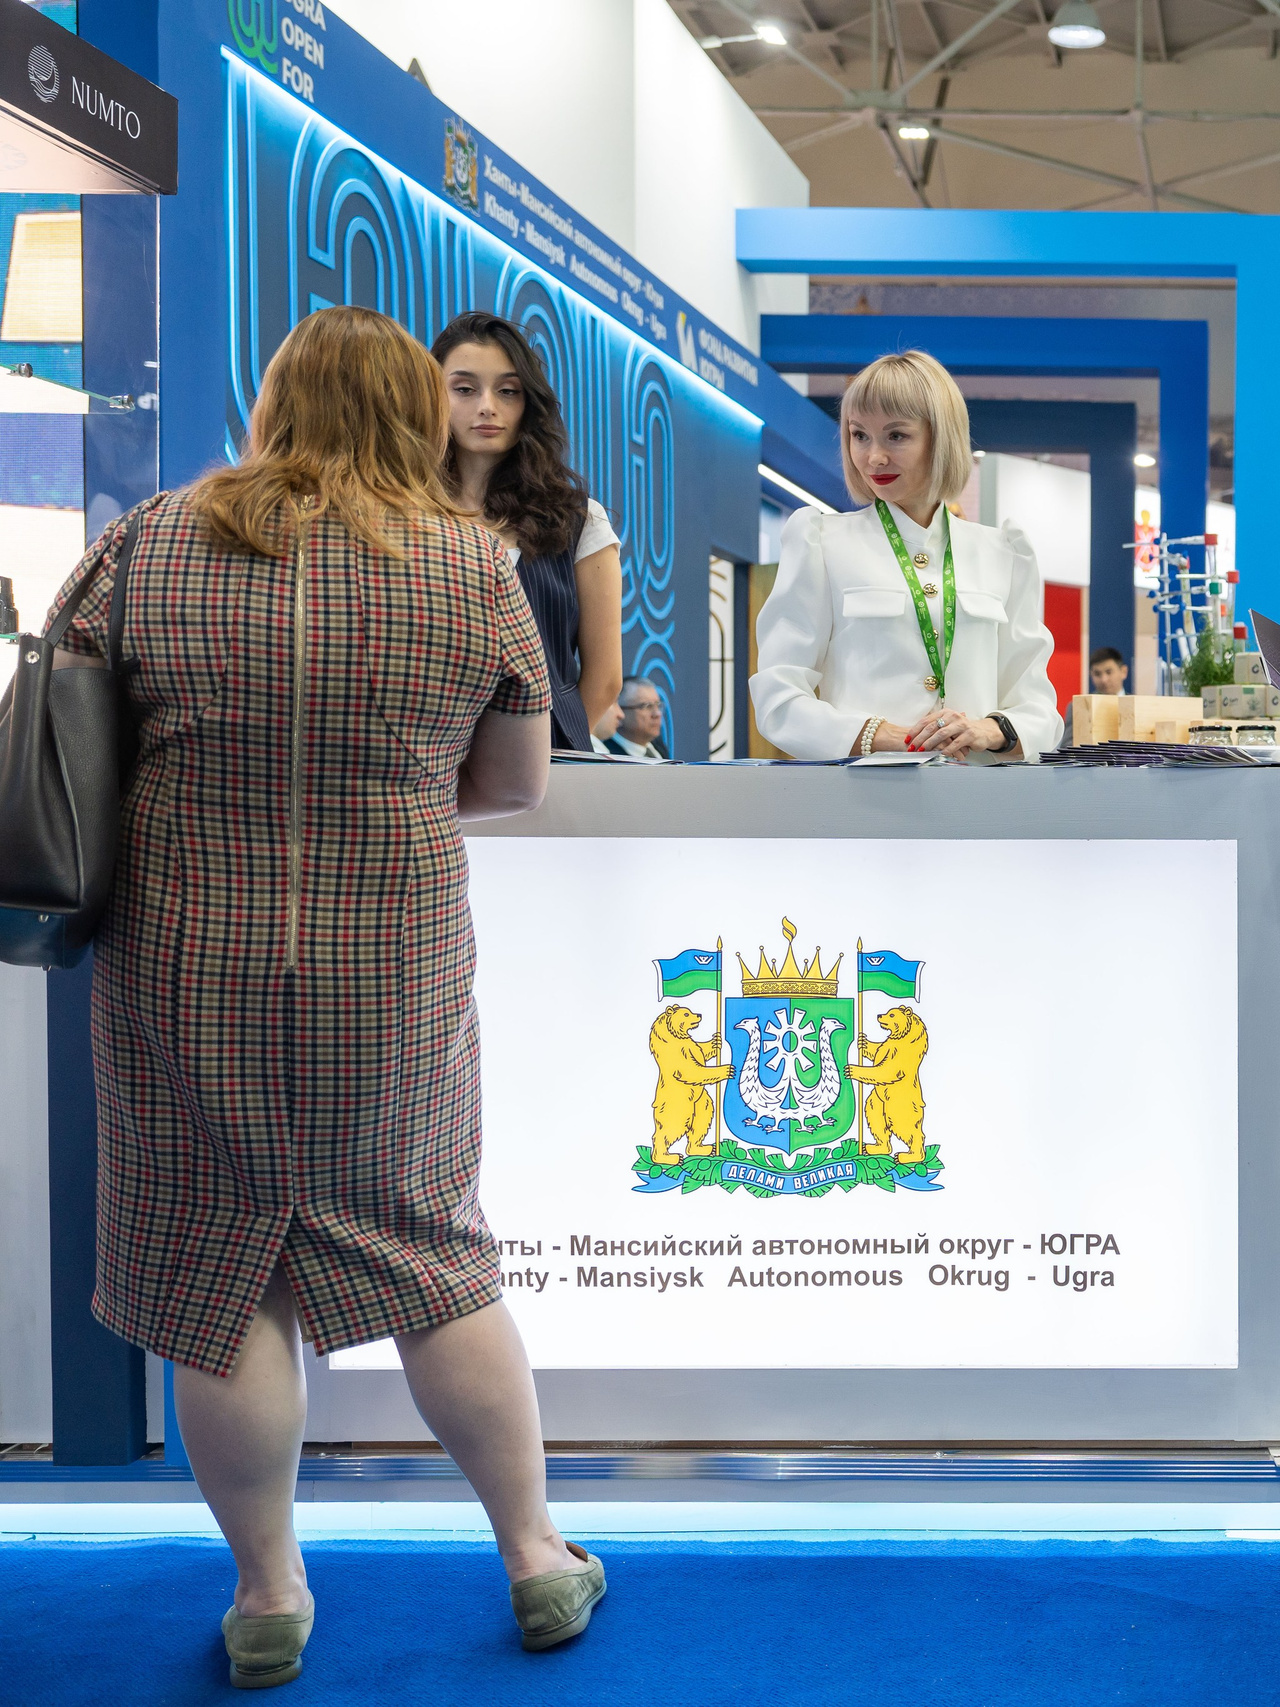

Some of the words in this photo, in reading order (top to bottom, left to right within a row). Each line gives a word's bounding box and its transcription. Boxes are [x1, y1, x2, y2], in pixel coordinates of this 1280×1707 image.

[285, 0, 326, 31] GRA
[281, 17, 324, 70] OPEN
[282, 57, 314, 103] FOR
[72, 76, 141, 139] NUMTO
[484, 191, 519, 238] Khanty
[525, 220, 566, 268] Mansiysk
[728, 1165, 784, 1190] ДЕЛАМИ
[794, 1163, 854, 1190] ВЕЛИКАЯ
[570, 1234, 742, 1256] Мансийский
[752, 1233, 930, 1256] автономный
[939, 1237, 1014, 1260] округ
[1041, 1233, 1121, 1256] ЮГРА
[577, 1266, 704, 1293] Mansiysk
[727, 1265, 903, 1288] Autonomous
[928, 1264, 1011, 1292] Okrug
[1053, 1265, 1115, 1292] Ugra
